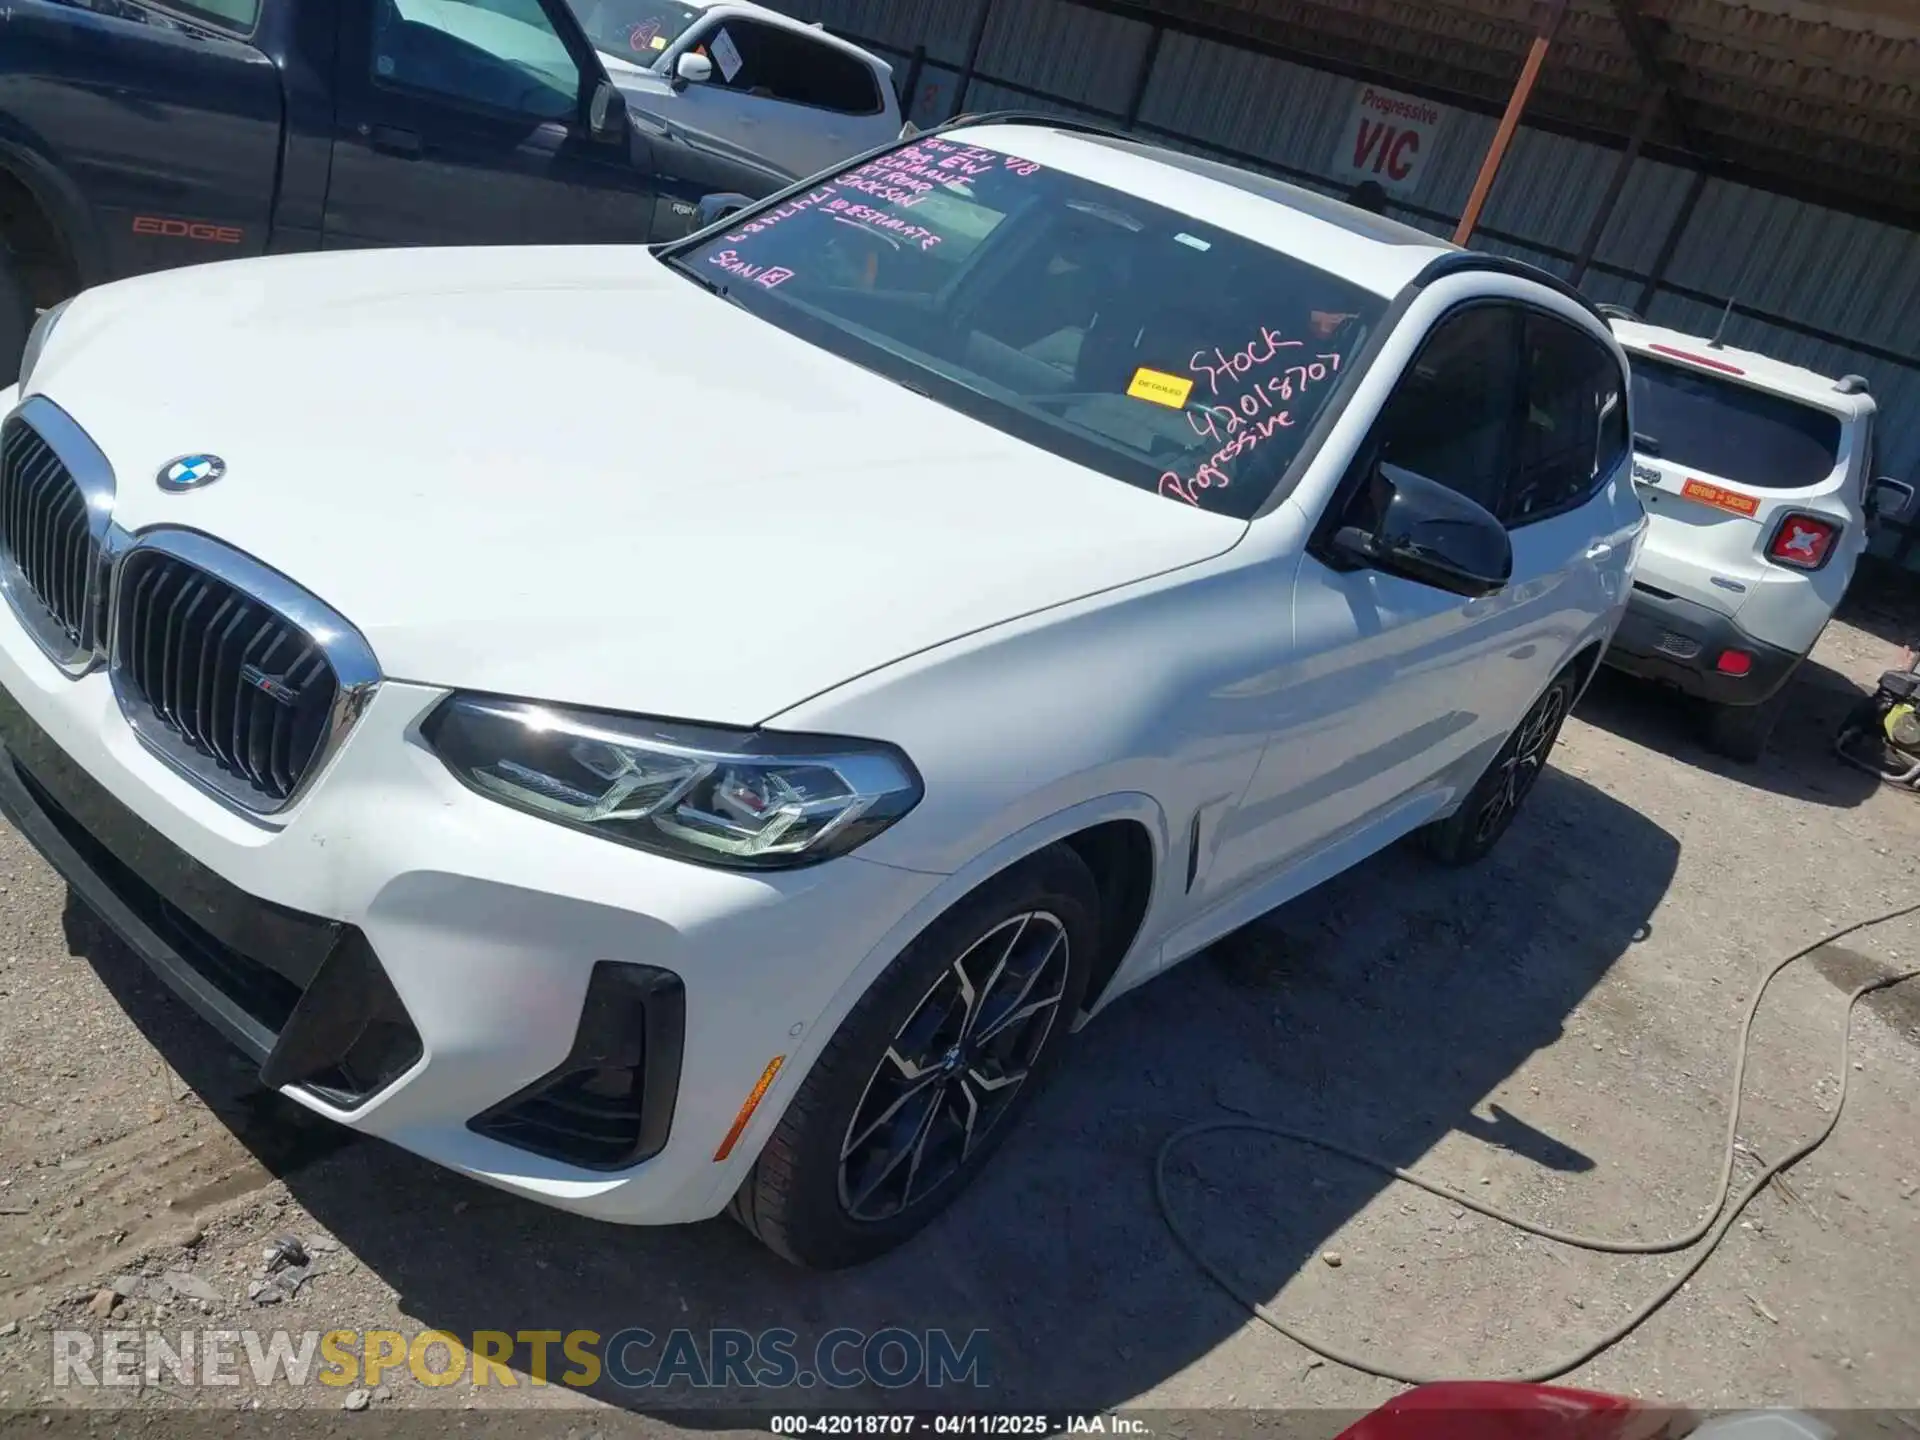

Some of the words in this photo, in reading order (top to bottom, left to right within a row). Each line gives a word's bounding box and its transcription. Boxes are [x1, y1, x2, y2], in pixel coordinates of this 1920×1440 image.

[1361, 88, 1438, 125] Progressive
[1352, 116, 1420, 181] VIC
[875, 156, 976, 186] CLAIMANT
[881, 171, 934, 194] REAR
[834, 174, 928, 208] JACKSON
[132, 216, 244, 243] EDGE
[844, 205, 942, 250] ESTIMATE
[708, 250, 762, 277] SCAN
[1186, 353, 1341, 444] 42018707
[1158, 410, 1295, 508] Progressive
